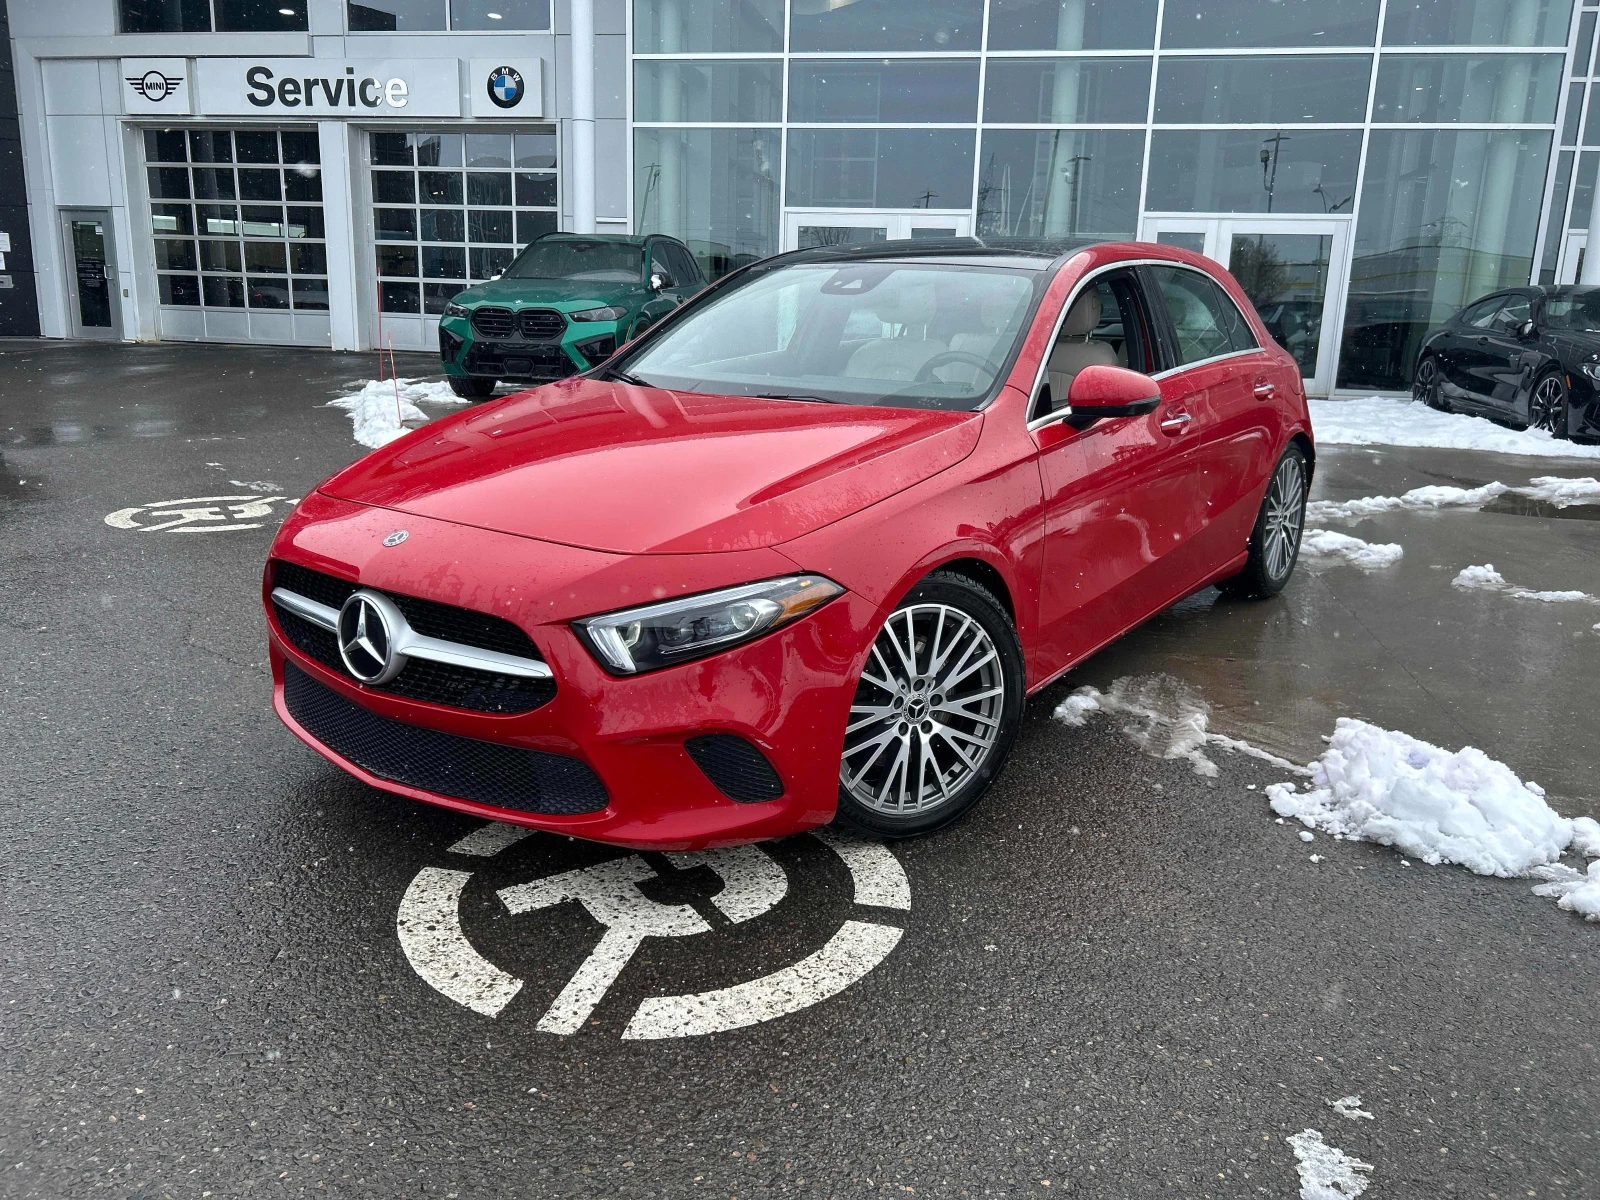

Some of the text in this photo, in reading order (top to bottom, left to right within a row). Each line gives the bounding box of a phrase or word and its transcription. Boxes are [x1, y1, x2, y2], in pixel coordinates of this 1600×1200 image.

[490, 67, 521, 82] BMW
[145, 82, 165, 91] MINI
[246, 66, 409, 108] Service
